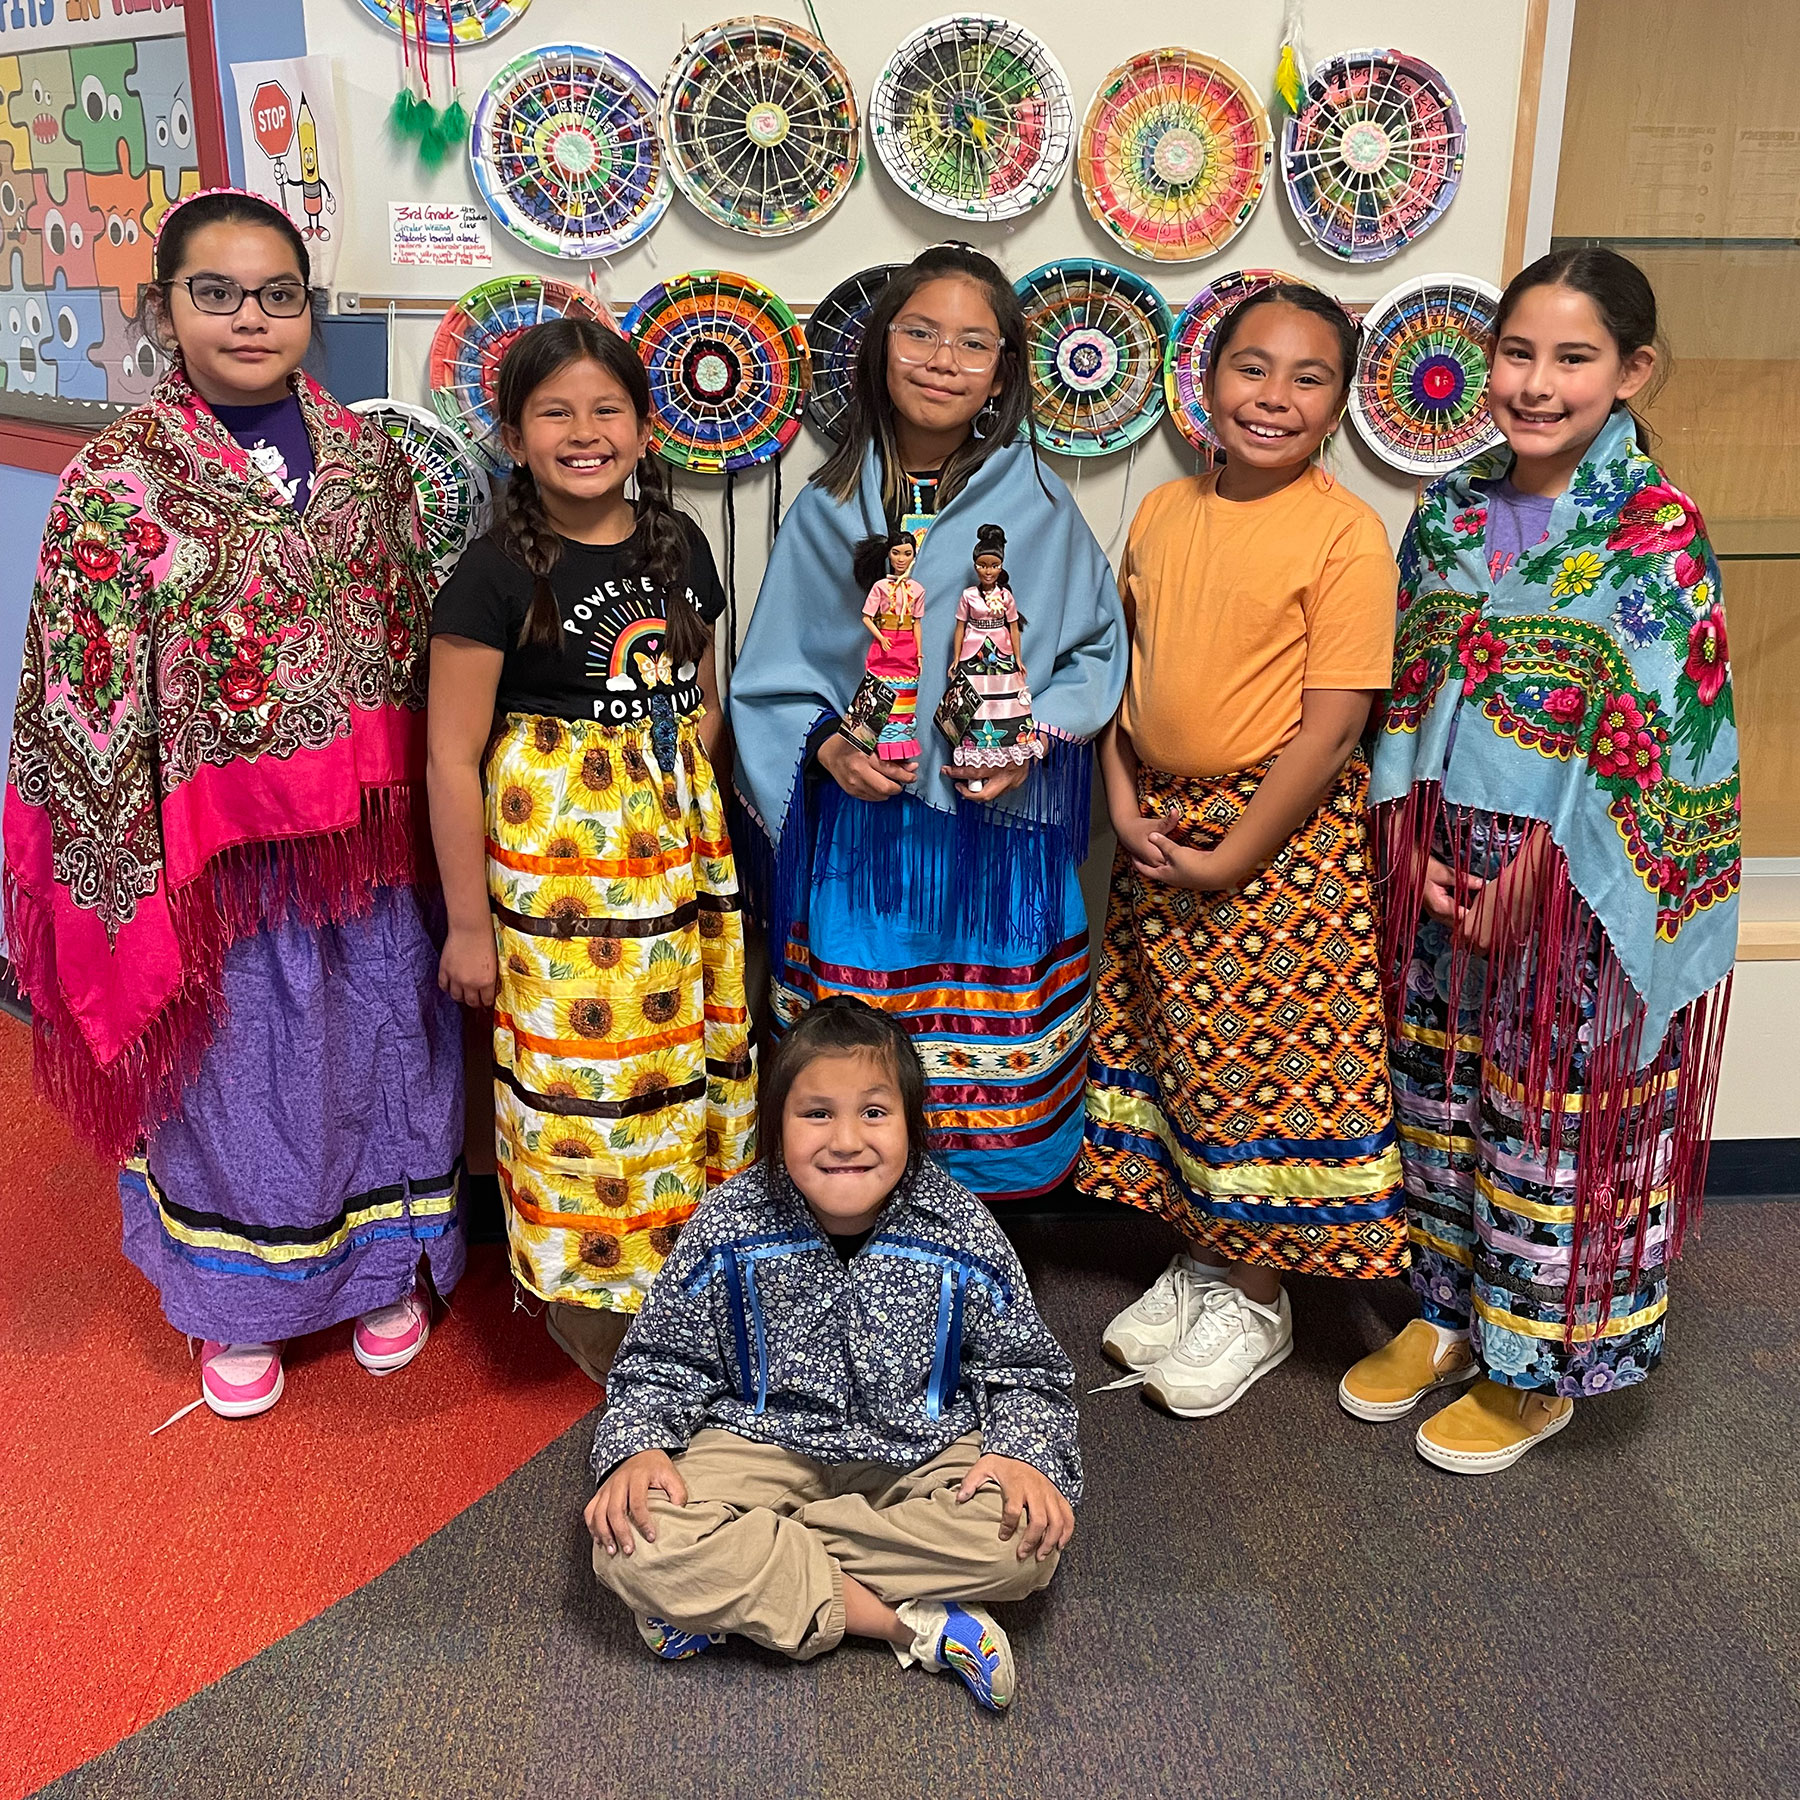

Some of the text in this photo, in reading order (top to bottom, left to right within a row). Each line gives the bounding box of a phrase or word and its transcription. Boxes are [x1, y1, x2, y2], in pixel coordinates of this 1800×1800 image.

[257, 105, 287, 133] STOP
[394, 206, 422, 221] 3rd
[424, 205, 459, 221] Grade
[394, 229, 480, 243] Students learned about
